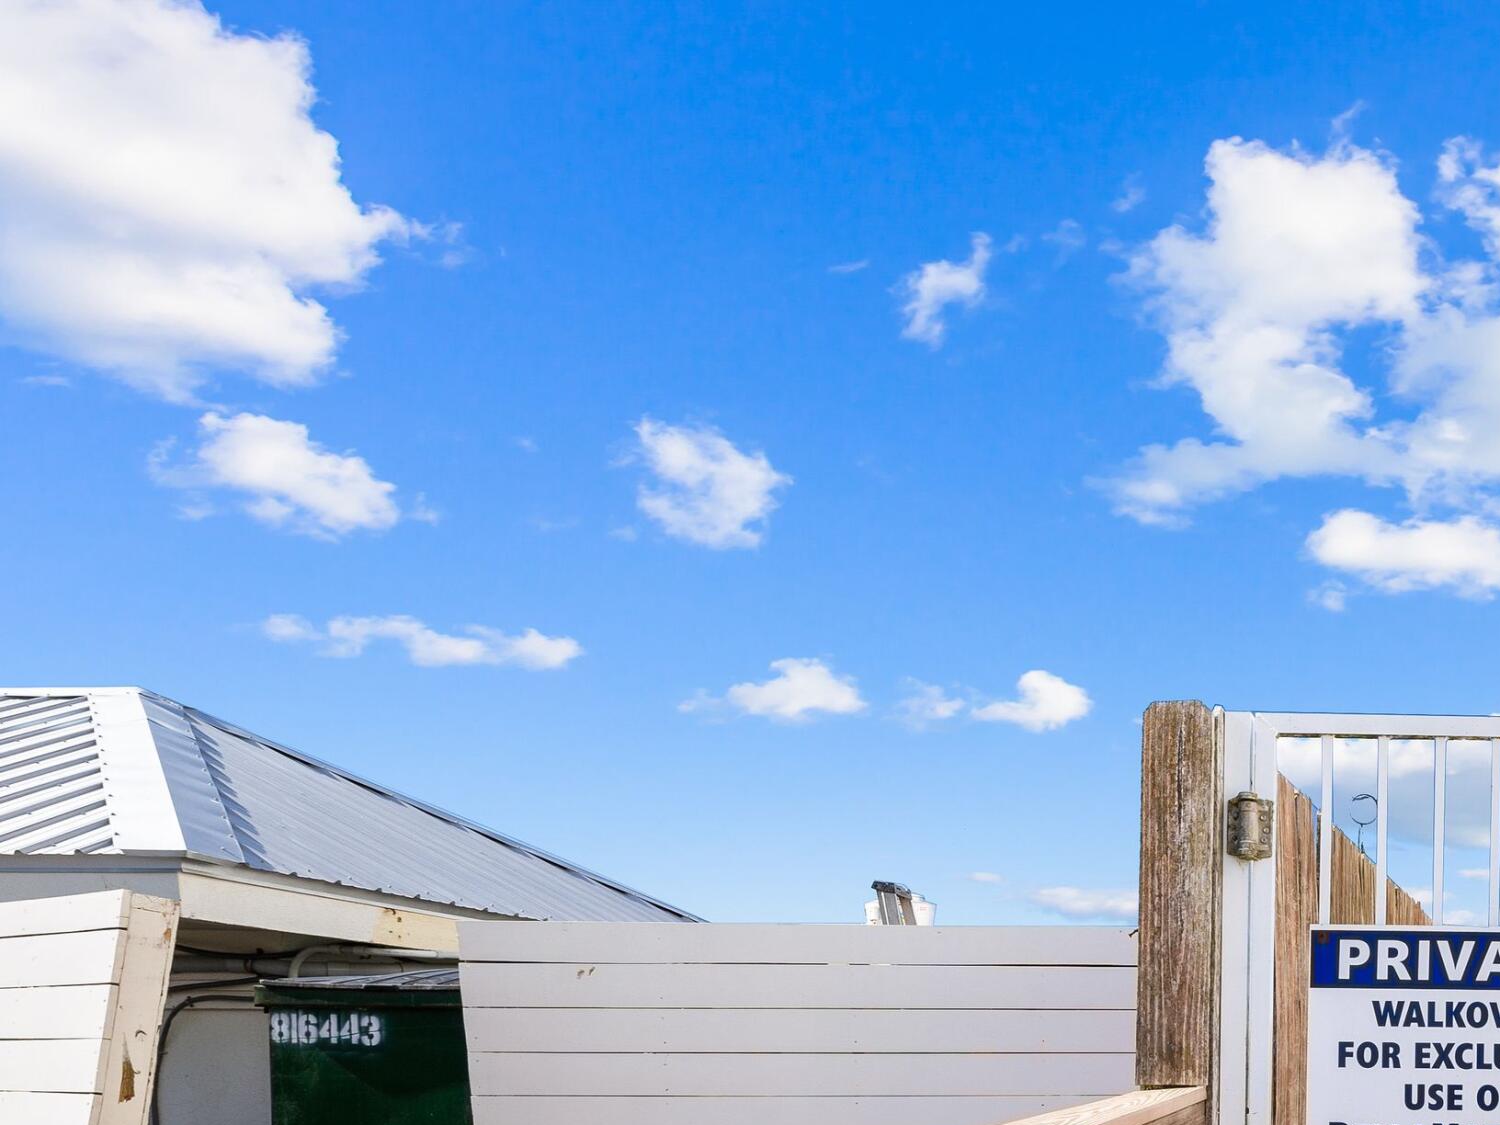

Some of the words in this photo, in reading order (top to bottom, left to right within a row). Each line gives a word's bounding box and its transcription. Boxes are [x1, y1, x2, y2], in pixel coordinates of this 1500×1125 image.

[270, 1012, 381, 1047] 816443
[1337, 1041, 1401, 1068] FOR
[1404, 1084, 1463, 1111] USE
